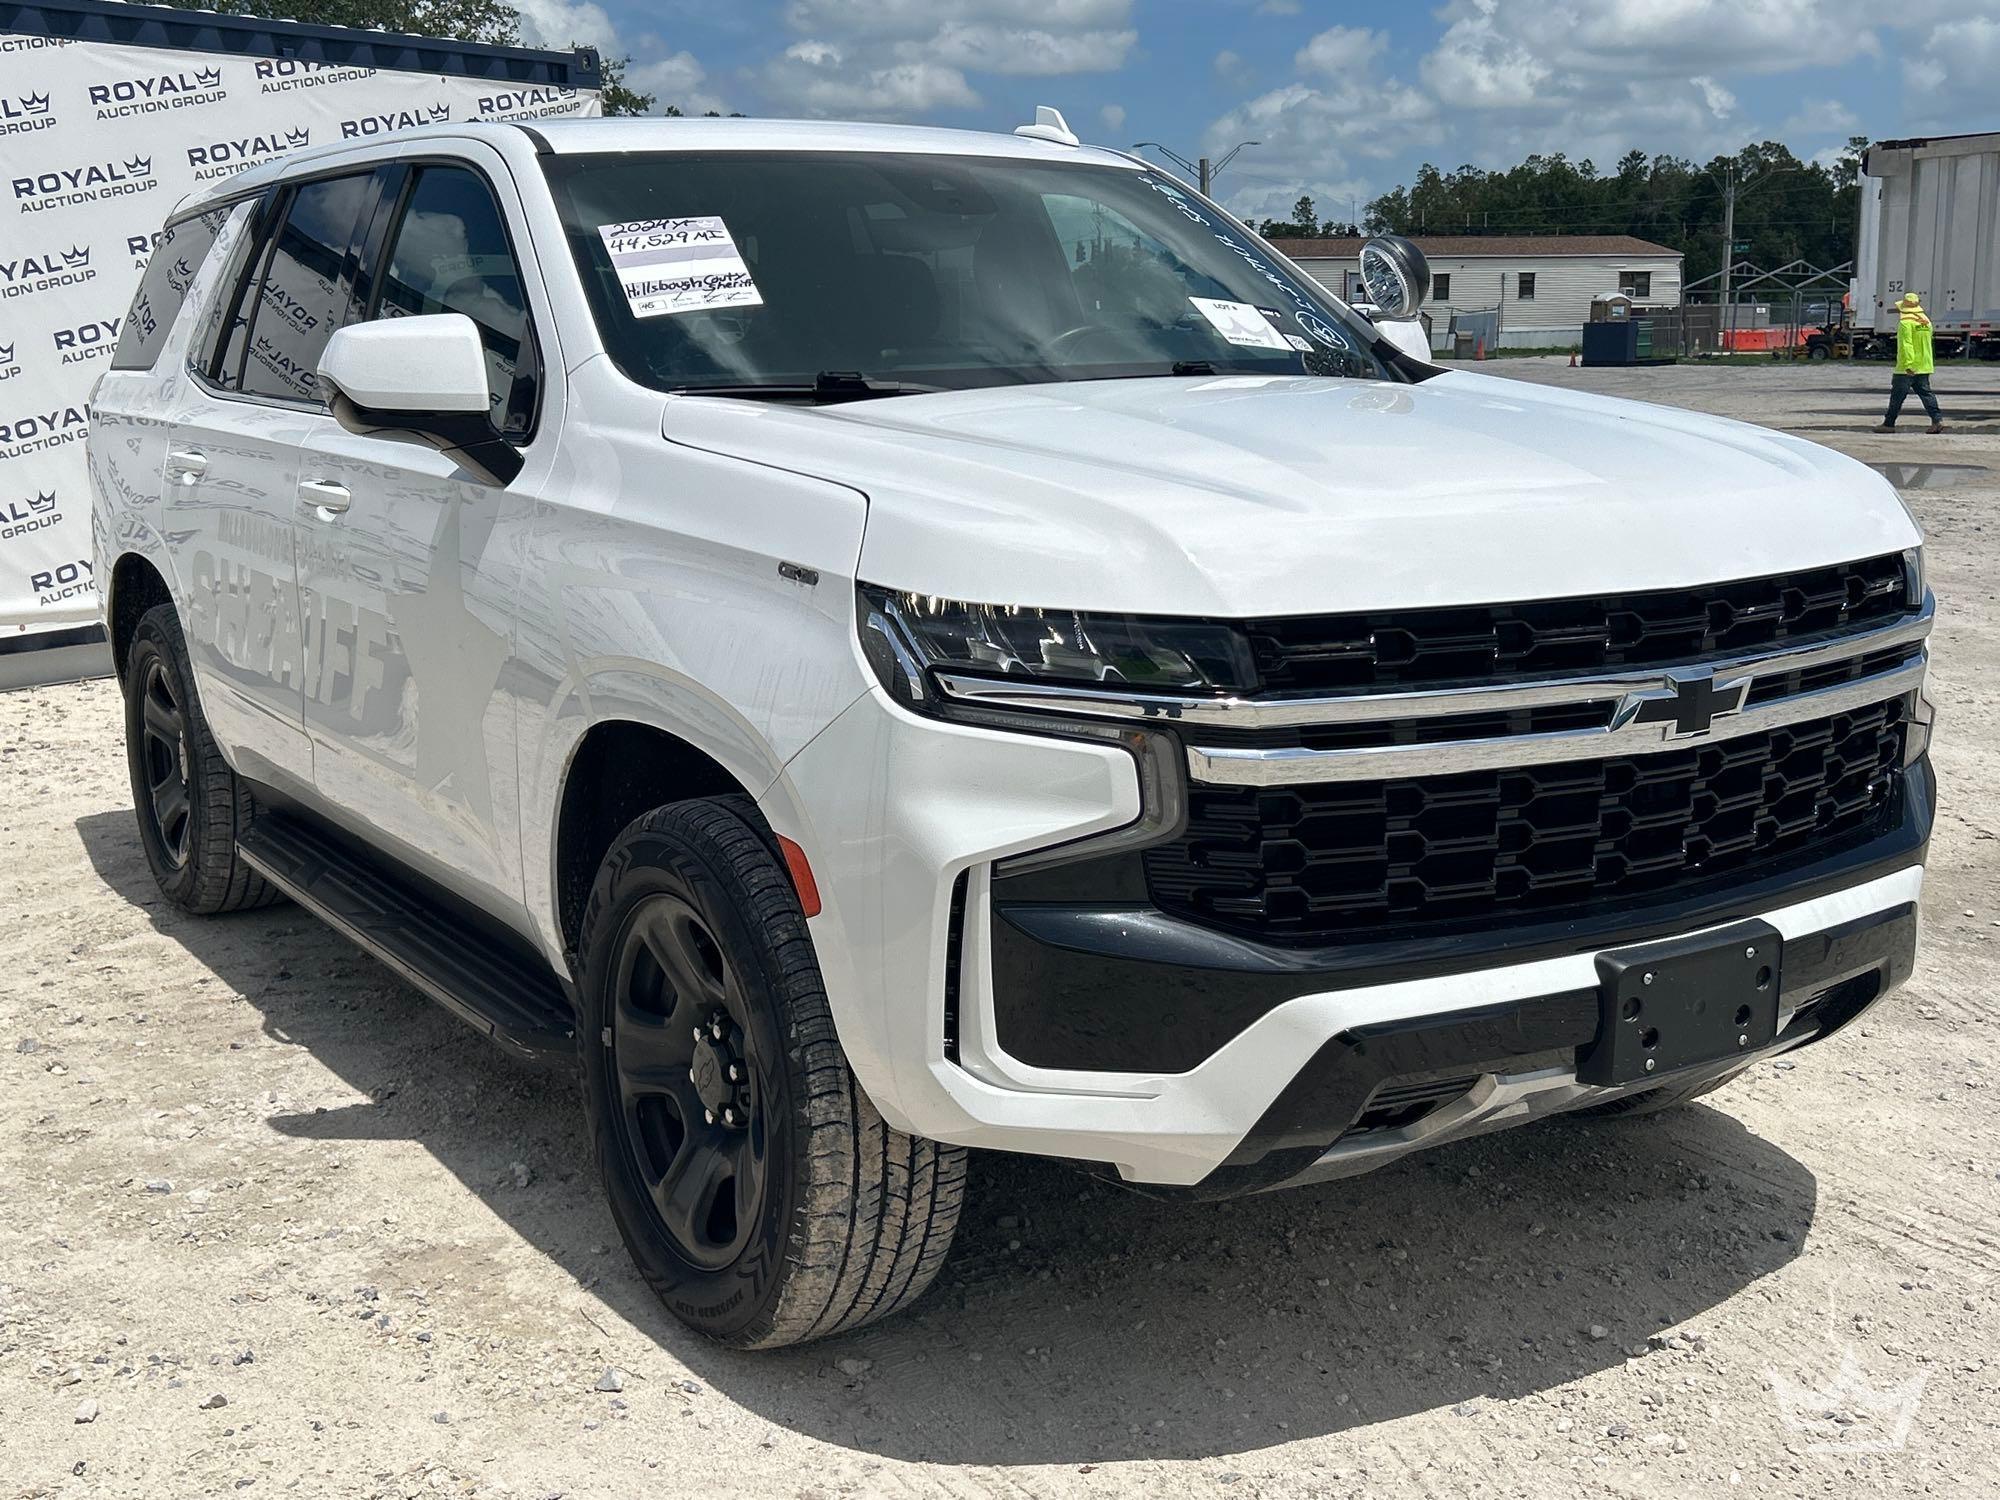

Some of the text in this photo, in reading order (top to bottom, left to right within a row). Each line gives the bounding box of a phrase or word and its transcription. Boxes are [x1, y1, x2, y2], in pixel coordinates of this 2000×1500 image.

[0, 37, 58, 52] CTION
[255, 60, 342, 79] ROY
[261, 68, 377, 94] AUCTION GROUP
[88, 74, 197, 105] ROYAL
[478, 88, 558, 114] ROYAL
[96, 91, 227, 120] AUCTION GROUP
[540, 102, 581, 117] GROUP
[340, 109, 430, 139] ROYAL
[187, 134, 287, 167] ROYAL
[12, 163, 126, 198] ROYAL
[20, 179, 158, 213] AUCTION GROUP
[0, 254, 63, 282] YAL
[36, 269, 96, 292] GROUP
[1889, 280, 1904, 292] 52
[53, 317, 121, 350] ROY
[2, 513, 62, 540] GROUP
[31, 560, 93, 592] ROY
